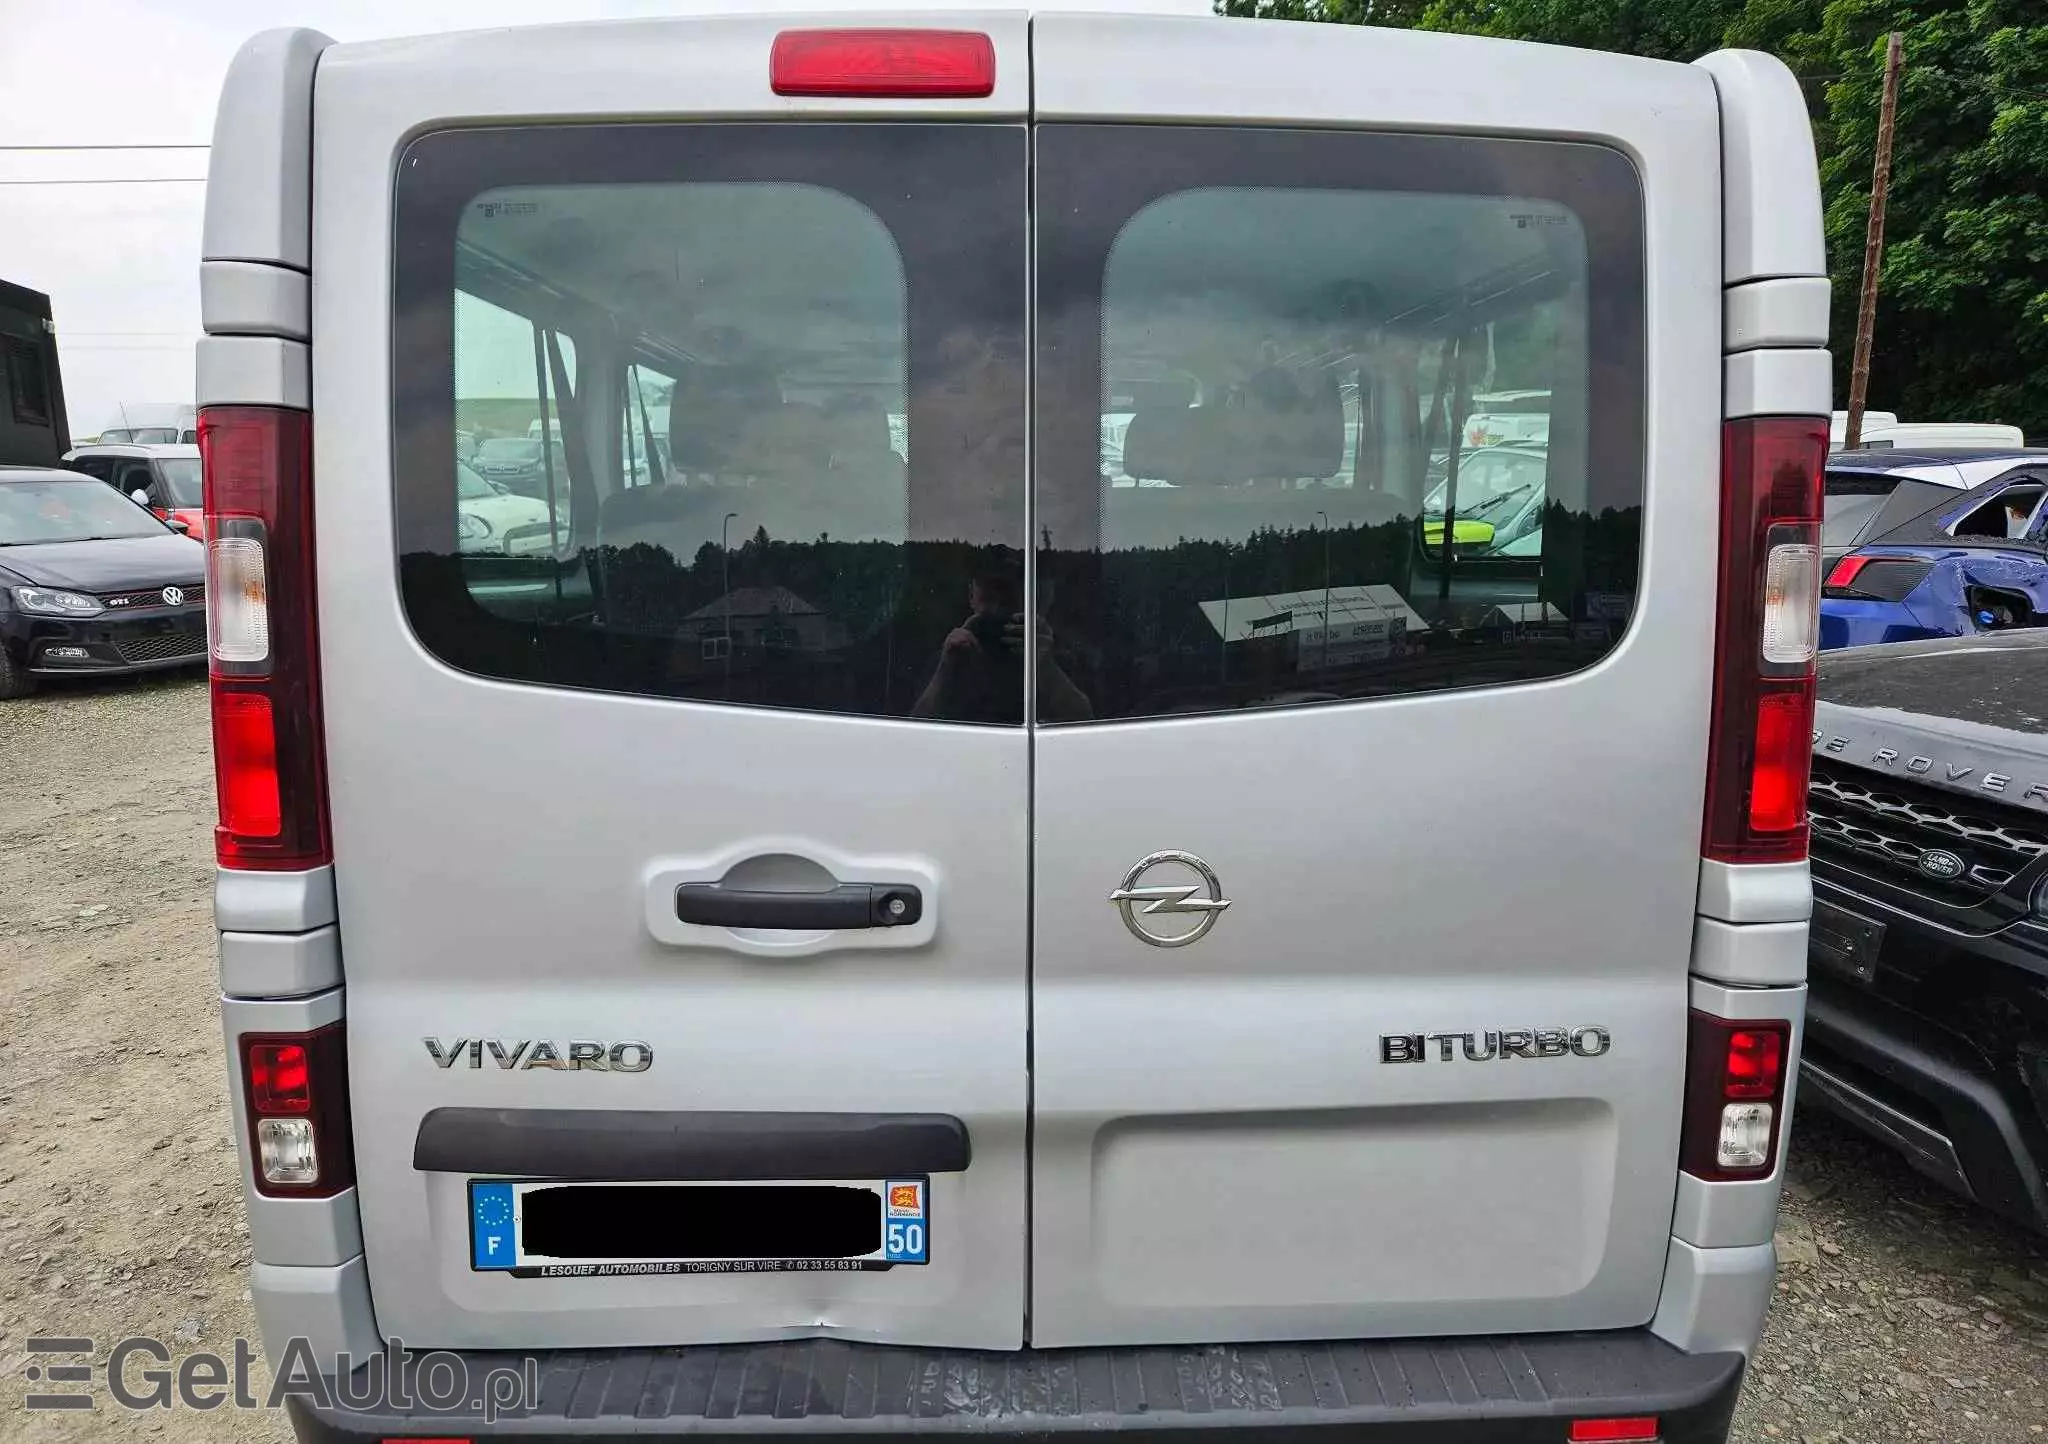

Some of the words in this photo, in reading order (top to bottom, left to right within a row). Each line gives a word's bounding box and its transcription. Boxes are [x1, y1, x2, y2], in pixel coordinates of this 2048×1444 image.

[1873, 748, 2048, 800] ROVER
[1924, 861, 1954, 874] ROVER
[422, 1036, 654, 1072] VIVARO
[488, 1236, 502, 1256] F
[888, 1223, 923, 1255] 50
[541, 1265, 596, 1276] LESOUEF
[598, 1263, 681, 1275] AUTOMOBILES
[687, 1262, 732, 1272] TORIGNY
[733, 1261, 756, 1271] SUR
[757, 1260, 782, 1271] VIRE
[796, 1260, 808, 1270] 02
[810, 1260, 822, 1270] 33
[824, 1260, 836, 1270] 55
[838, 1260, 849, 1270] 83
[851, 1260, 862, 1270] 91
